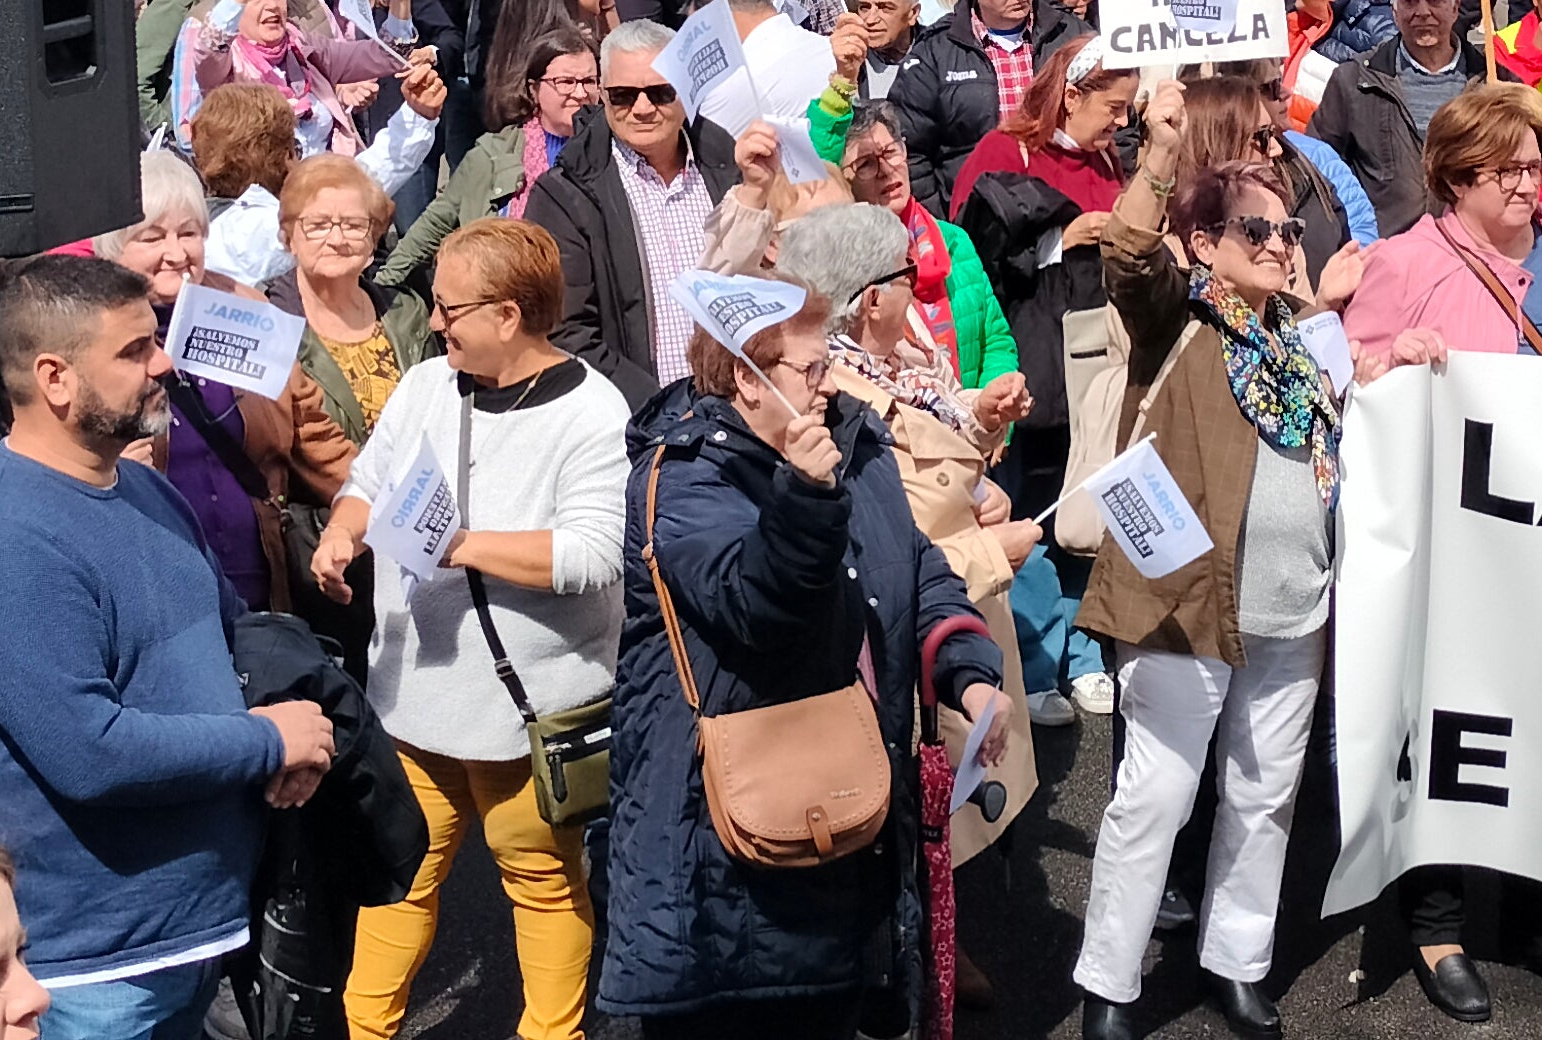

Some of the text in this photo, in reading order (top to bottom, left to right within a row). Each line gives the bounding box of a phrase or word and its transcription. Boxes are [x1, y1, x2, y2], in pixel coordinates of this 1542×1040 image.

[946, 70, 978, 81] Joma
[204, 302, 275, 333] JARRIO
[724, 301, 785, 337] OSPITAL!
[185, 347, 263, 378] HOSPITAL!
[189, 338, 245, 359] NUESTRO
[1143, 471, 1187, 532] JARRIO
[1396, 708, 1513, 808] E
